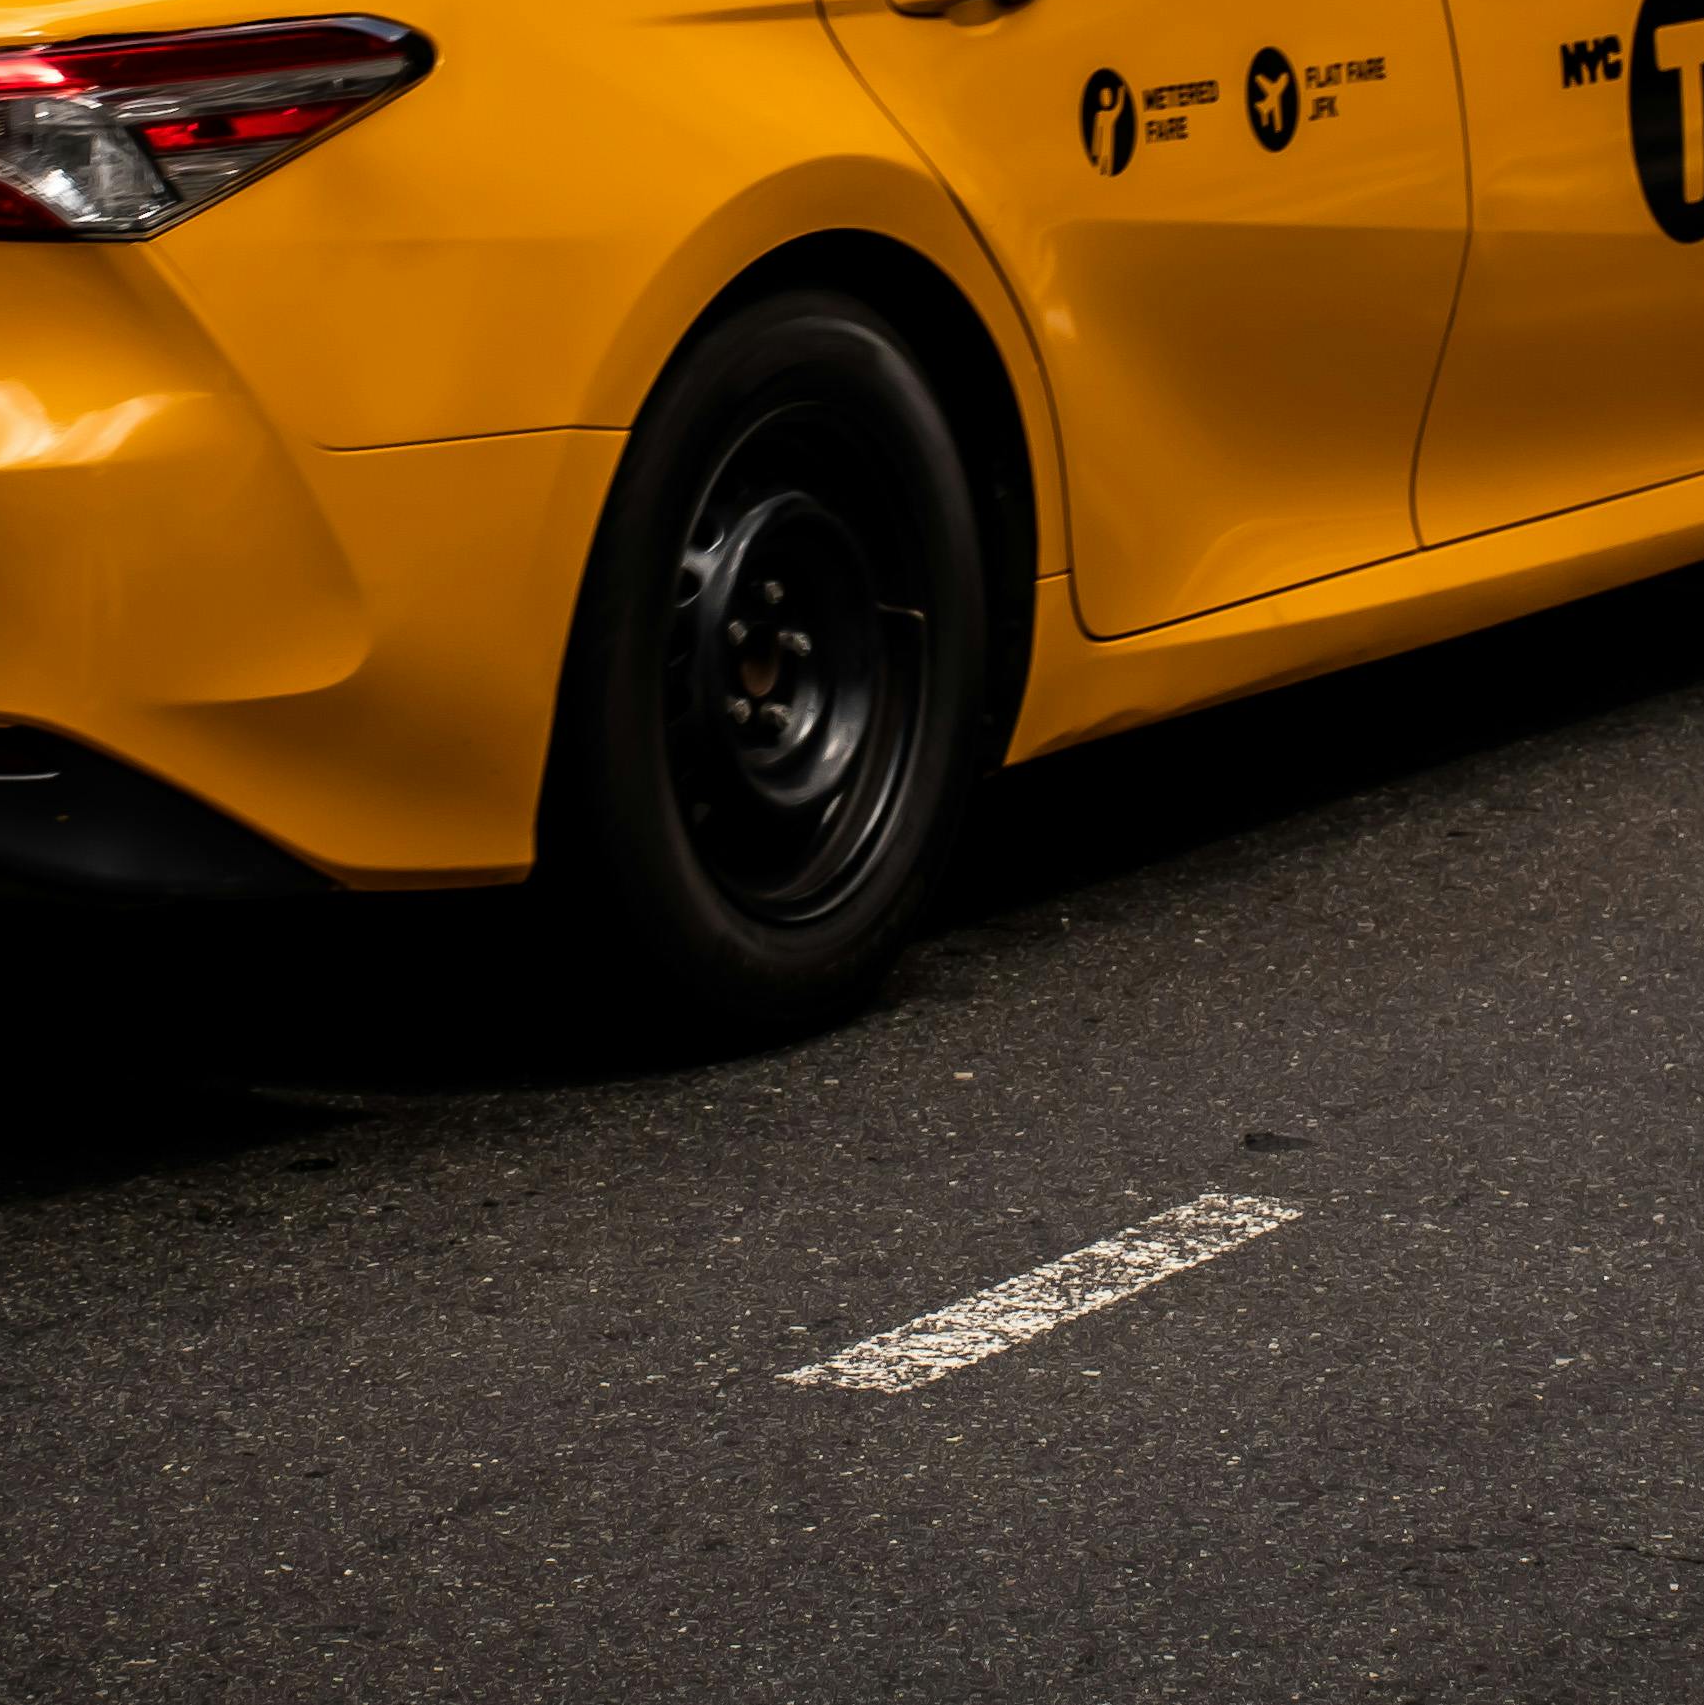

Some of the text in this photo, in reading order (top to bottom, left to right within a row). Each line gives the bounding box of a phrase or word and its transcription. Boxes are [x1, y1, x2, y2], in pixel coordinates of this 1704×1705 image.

[1305, 57, 1387, 90] FLAT FARE
[1560, 34, 1623, 88] NYC
[1142, 80, 1220, 112] METERED
[1308, 96, 1340, 121] JFK
[1145, 116, 1189, 144] FARE
